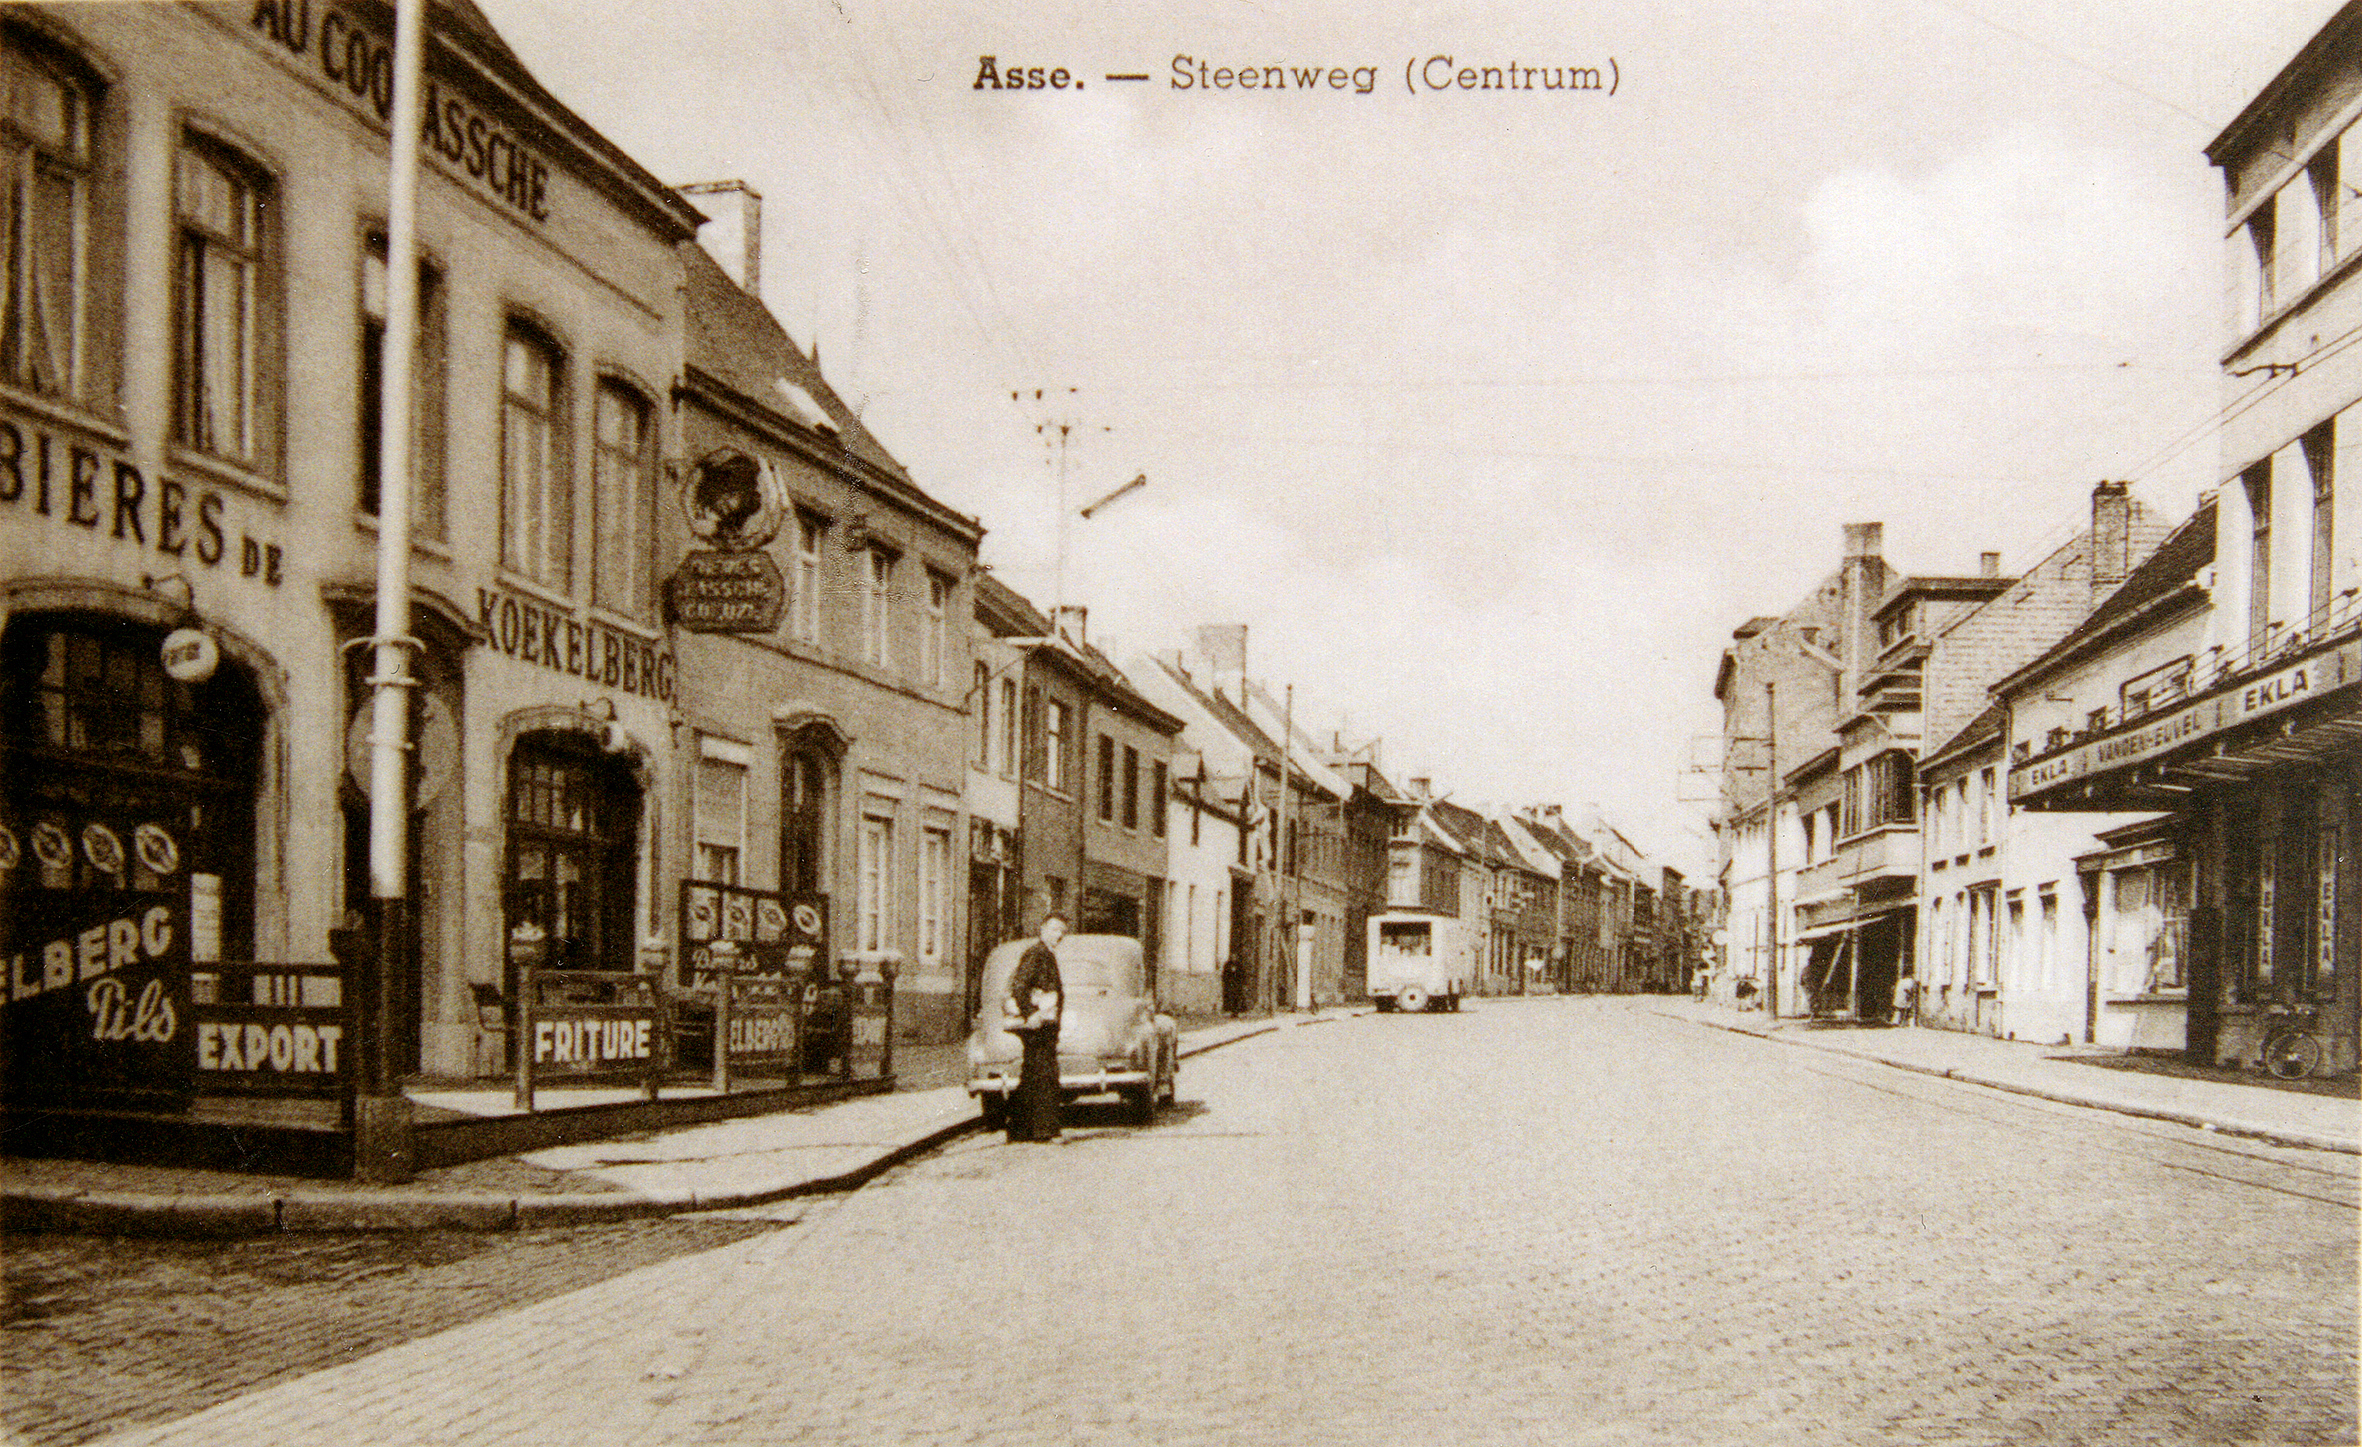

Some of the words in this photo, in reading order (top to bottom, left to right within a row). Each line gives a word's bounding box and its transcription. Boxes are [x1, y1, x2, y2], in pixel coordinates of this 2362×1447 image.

[241, 534, 283, 588] DE
[477, 587, 674, 702] KOEKELBERG
[2244, 668, 2309, 712] EKLA
[2031, 758, 2067, 786] EKLA
[0, 905, 173, 1005] LBERG
[86, 976, 177, 1042] Pils
[198, 1022, 344, 1073] EXPORT
[534, 1018, 652, 1064] FRITURE
